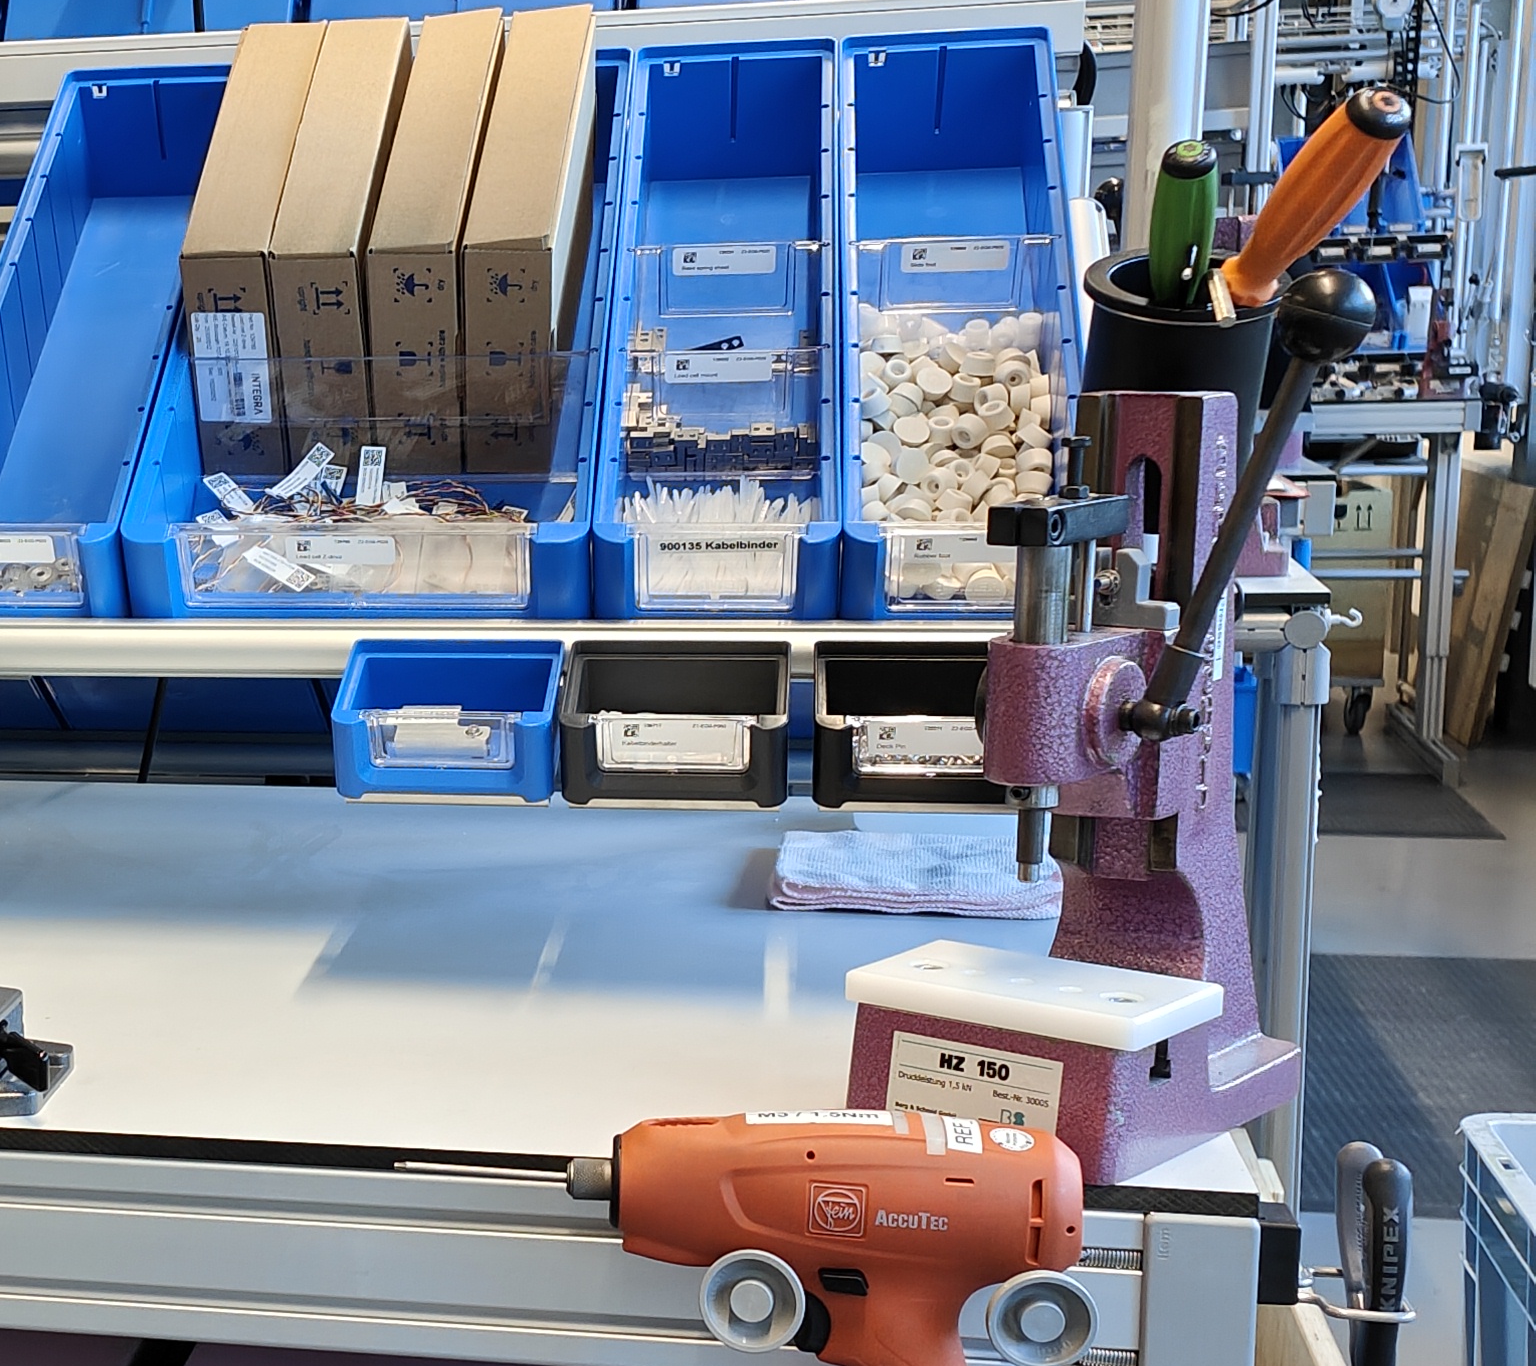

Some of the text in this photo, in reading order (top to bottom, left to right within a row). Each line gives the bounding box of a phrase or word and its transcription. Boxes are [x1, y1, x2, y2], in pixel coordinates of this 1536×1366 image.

[251, 373, 264, 415] INTEGRA
[659, 540, 778, 551] 900135 Kabelbinder
[939, 1053, 1010, 1081] HZ 150
[949, 1081, 960, 1090] 1,5
[1377, 1204, 1401, 1312] KNIPEX
